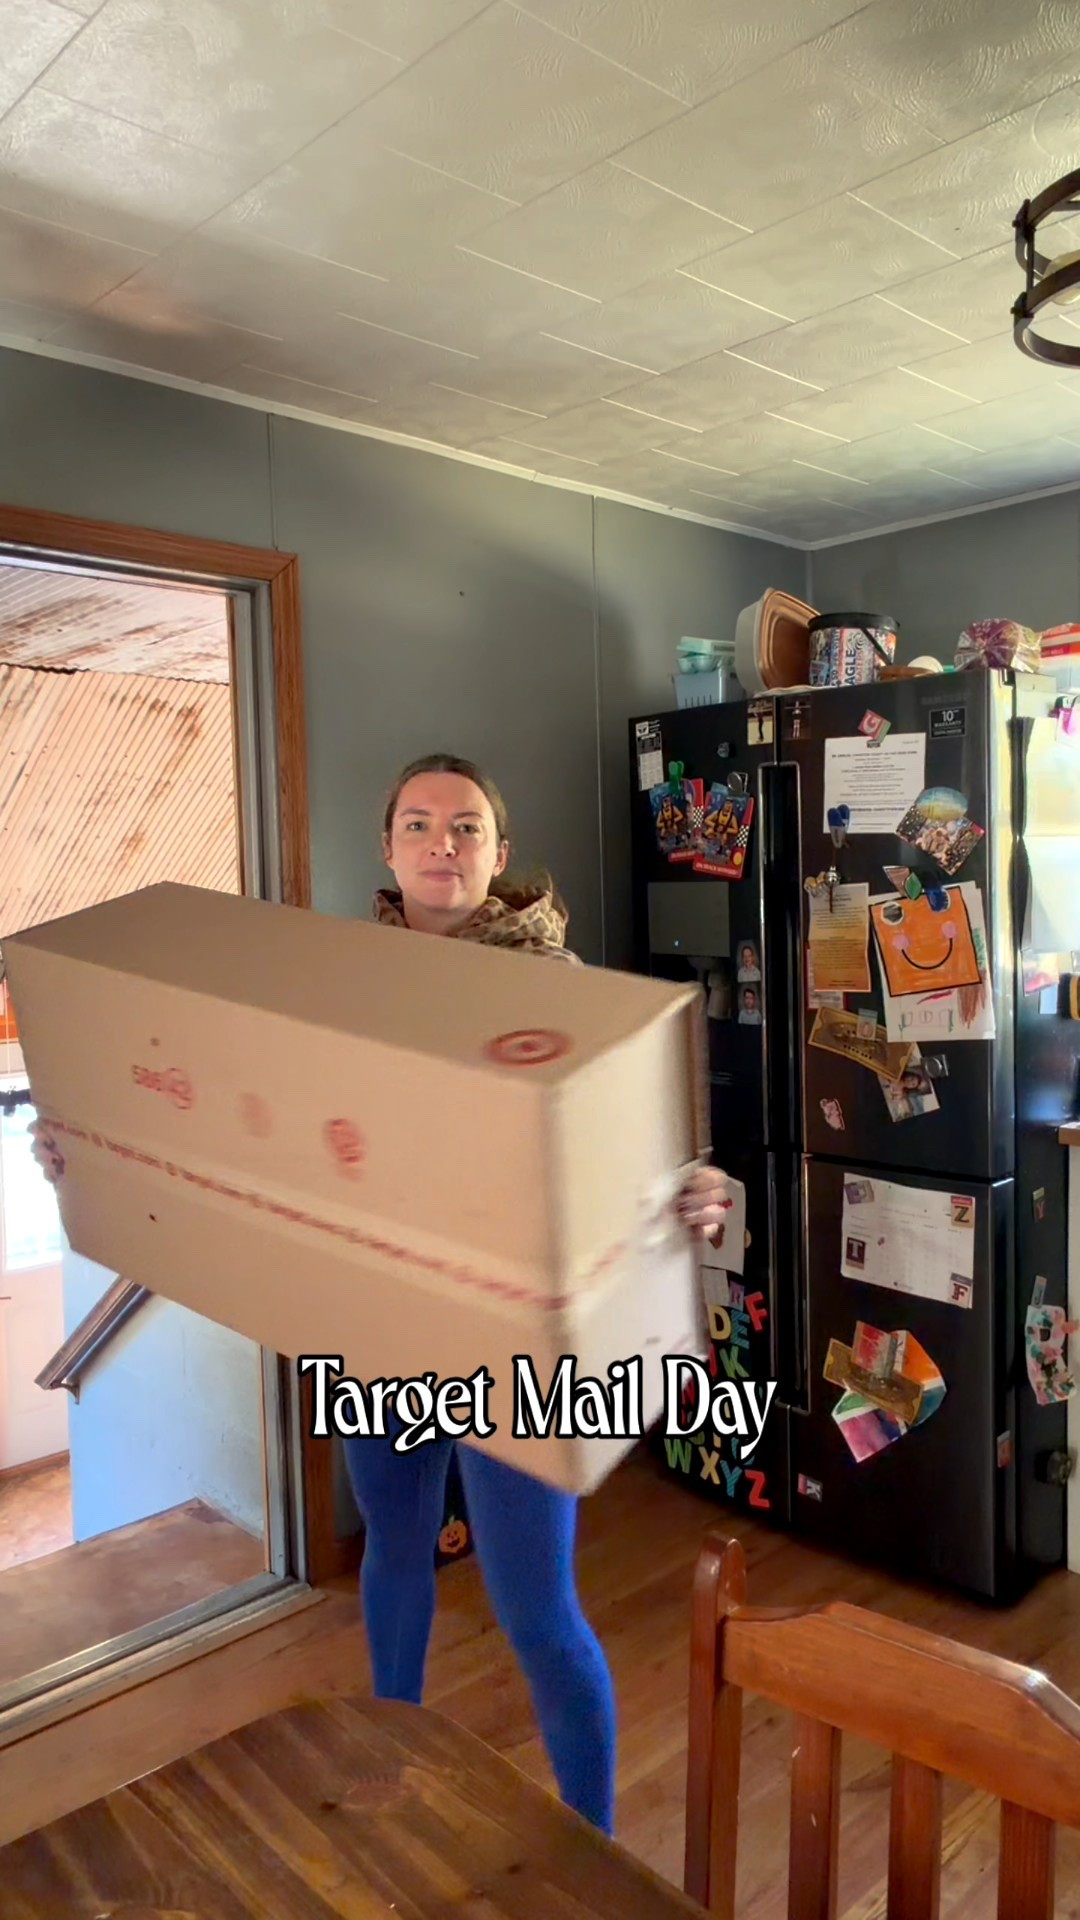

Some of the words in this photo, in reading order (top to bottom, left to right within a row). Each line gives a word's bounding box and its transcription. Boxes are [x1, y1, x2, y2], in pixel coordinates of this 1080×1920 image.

[845, 649, 856, 687] AGLE
[942, 710, 954, 721] 10
[954, 1205, 970, 1223] Z
[847, 1240, 864, 1259] T
[951, 1282, 969, 1301] F
[707, 1304, 731, 1340] D
[730, 1309, 750, 1350] E
[745, 1291, 768, 1331] F
[719, 1345, 750, 1380] K
[664, 1438, 692, 1474] W
[698, 1446, 720, 1485] X
[720, 1460, 742, 1498] Y
[744, 1469, 770, 1508] Z
